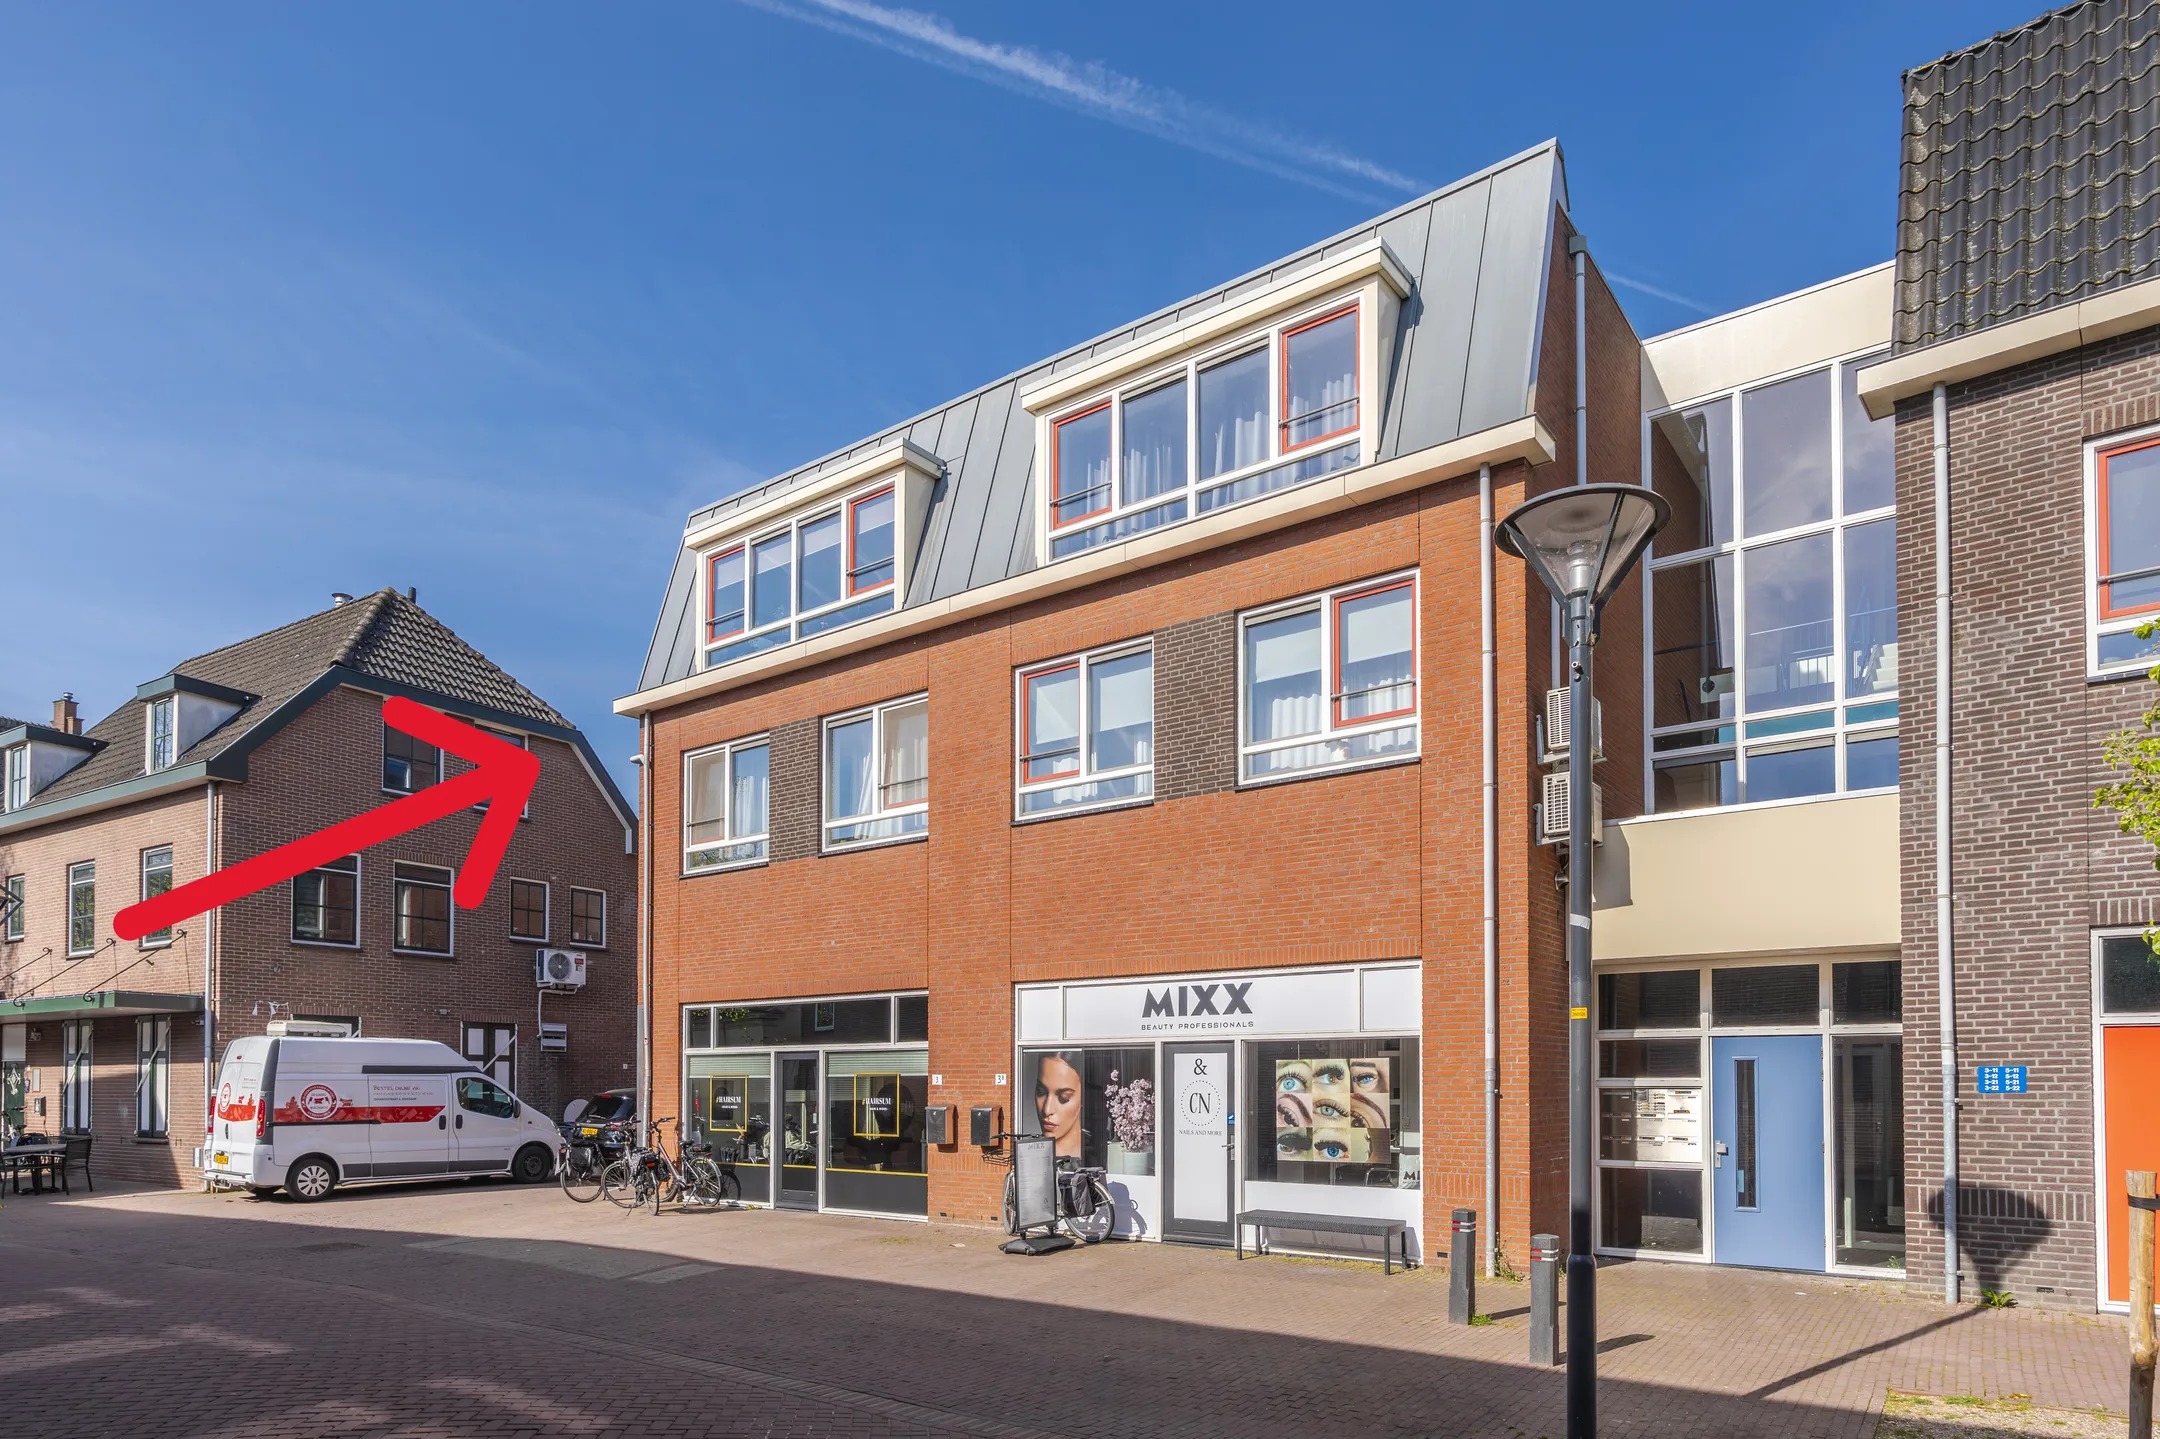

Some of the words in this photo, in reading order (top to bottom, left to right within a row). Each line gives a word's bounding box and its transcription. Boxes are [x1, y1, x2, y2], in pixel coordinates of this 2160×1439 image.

[1142, 982, 1253, 1018] MIXX
[1141, 1023, 1174, 1031] BEAUTY
[1178, 1021, 1254, 1030] PROFESSIONALS
[1193, 1058, 1208, 1075] &
[1189, 1092, 1211, 1114] CN
